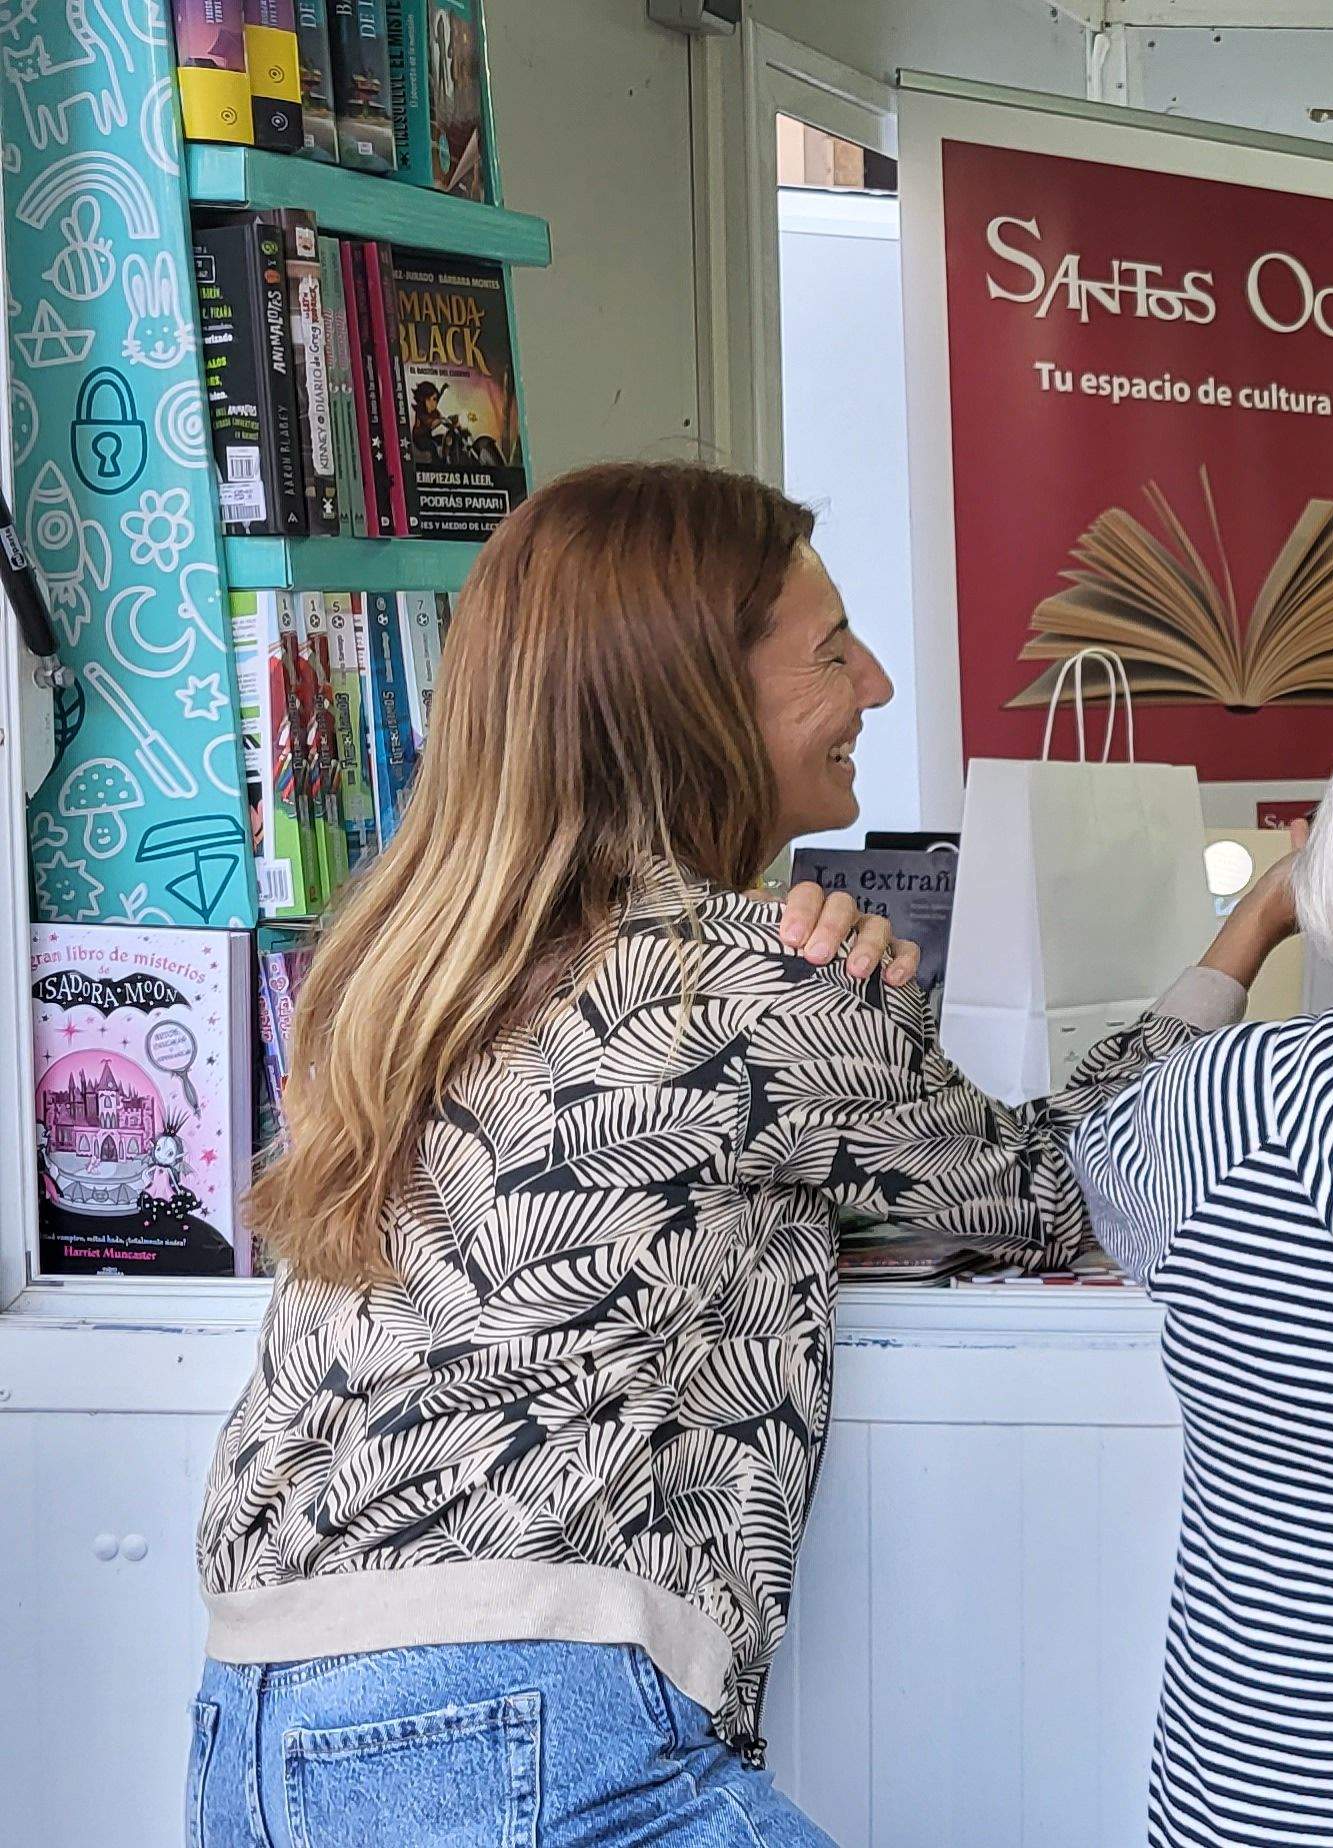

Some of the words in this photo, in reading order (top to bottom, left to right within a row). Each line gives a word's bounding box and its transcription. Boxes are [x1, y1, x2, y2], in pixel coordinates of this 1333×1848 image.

[471, 278, 501, 290] MONTES
[267, 290, 287, 376] ANIMALOTES
[308, 326, 323, 354] Greg
[311, 366, 327, 414] DIARIO
[1033, 361, 1074, 394] Tu
[1080, 371, 1192, 405] espacio
[1197, 377, 1232, 407] de
[1238, 381, 1332, 416] cultura
[276, 403, 291, 454] BLABEY
[316, 428, 331, 471] KINNEY
[415, 471, 462, 486] EMPIEZAS
[471, 474, 495, 487] LEER,
[419, 495, 464, 509] PODRÁS
[441, 522, 468, 531] MEDIO
[66, 945, 104, 962] libro
[108, 946, 130, 963] de
[133, 950, 207, 985] misterios
[37, 973, 114, 1008] ISADORA
[63, 1245, 102, 1260] Harriet
[103, 1246, 158, 1262] Muncaster
